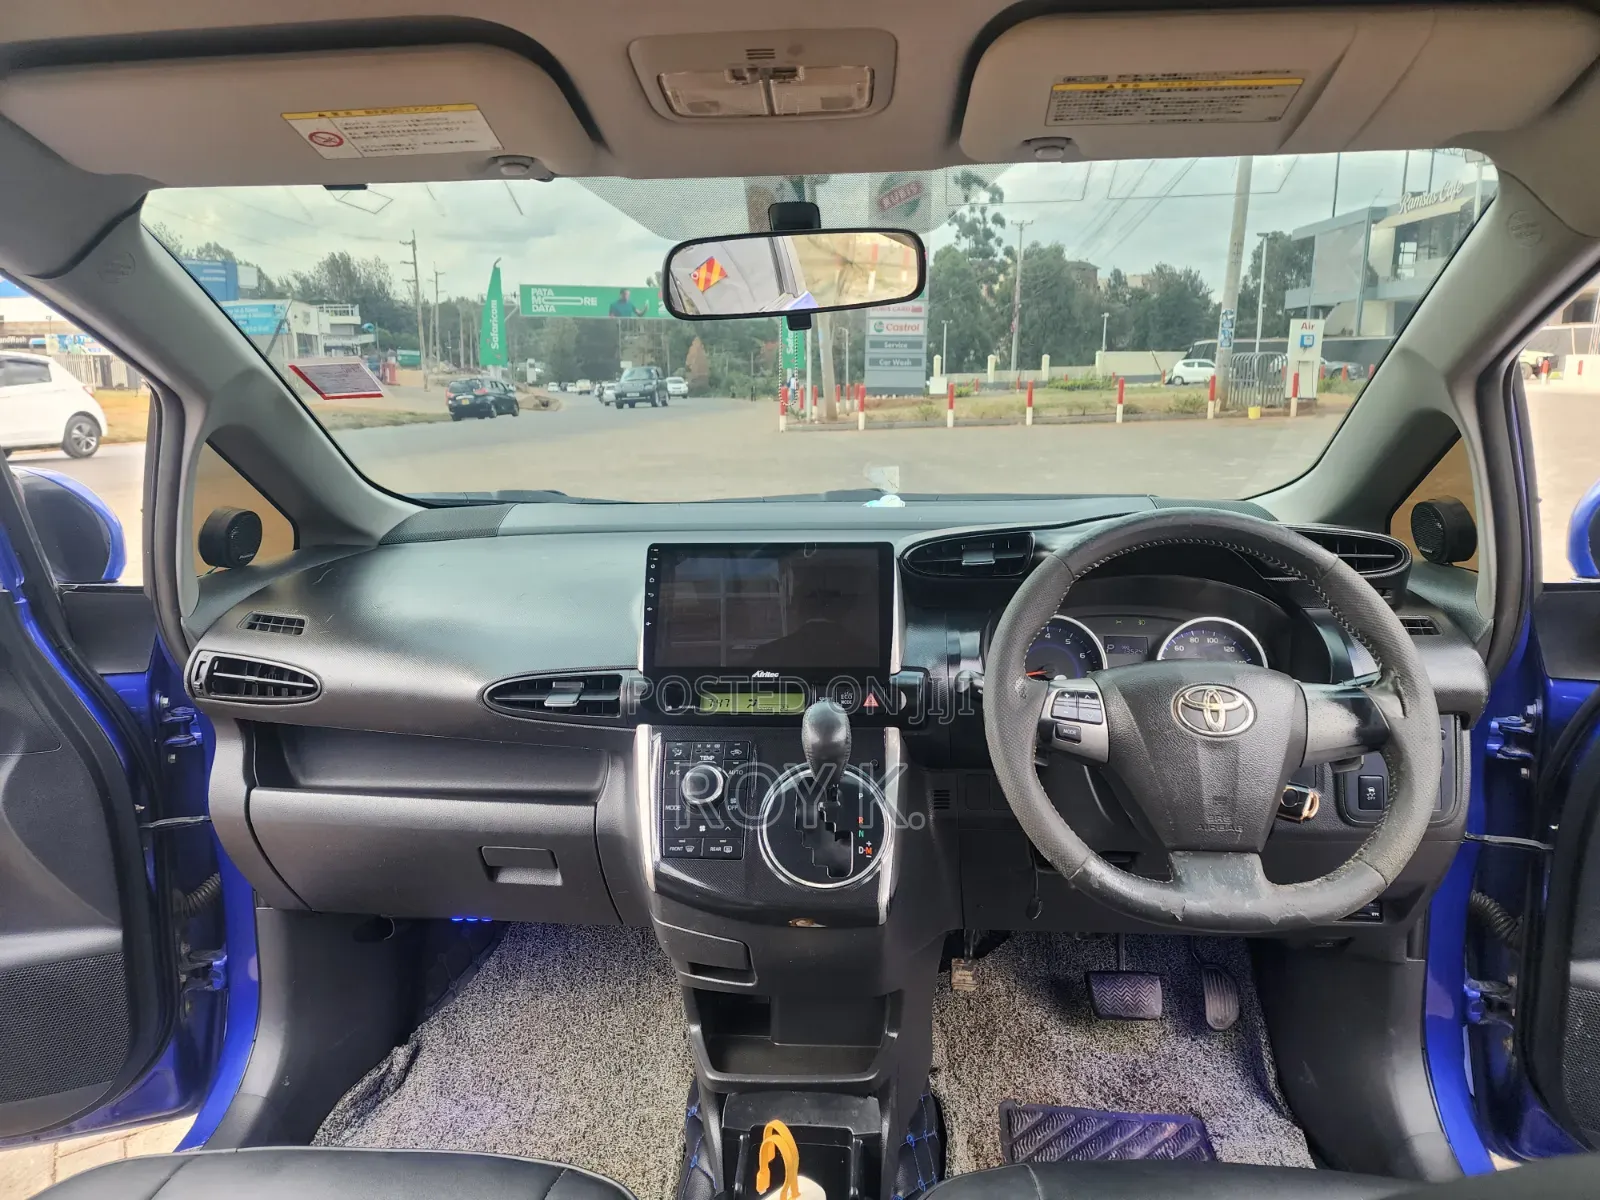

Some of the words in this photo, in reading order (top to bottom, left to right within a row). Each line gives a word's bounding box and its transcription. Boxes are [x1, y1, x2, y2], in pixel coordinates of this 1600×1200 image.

[531, 288, 555, 296] PATA
[532, 296, 598, 306] MORE
[532, 305, 556, 313] DATA
[491, 299, 499, 350] Safaricom
[886, 323, 920, 333] Castrol
[1301, 321, 1316, 330] Air
[884, 341, 908, 349] Service
[879, 358, 892, 366] Car
[892, 358, 912, 366] Wash
[858, 792, 864, 800] P
[858, 816, 864, 824] R
[858, 829, 865, 838] N
[858, 845, 864, 855] D
